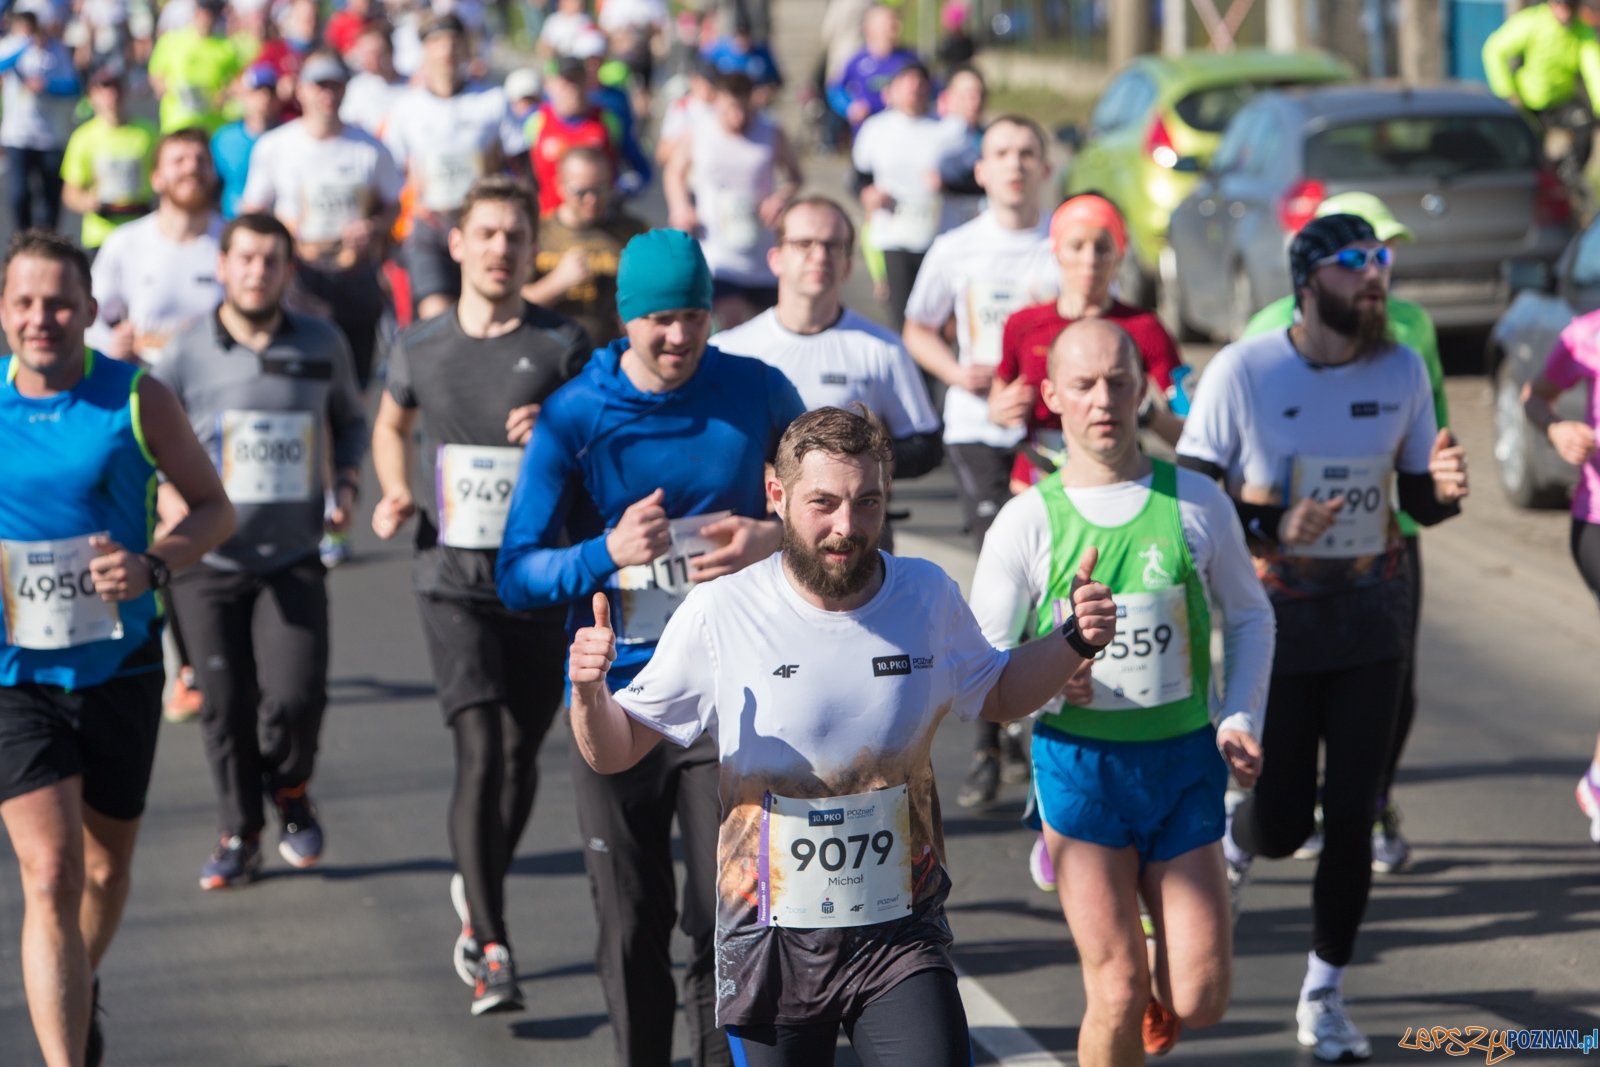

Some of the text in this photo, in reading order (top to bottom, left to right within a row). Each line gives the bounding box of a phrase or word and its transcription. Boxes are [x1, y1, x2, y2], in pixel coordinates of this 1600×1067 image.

[18, 568, 95, 602] 4950
[1094, 624, 1172, 661] 559
[772, 664, 800, 678] 4F
[877, 660, 908, 671] 10. PKO
[812, 813, 842, 822] 10. PKO
[791, 830, 893, 871] 9079
[828, 874, 864, 886] Michał
